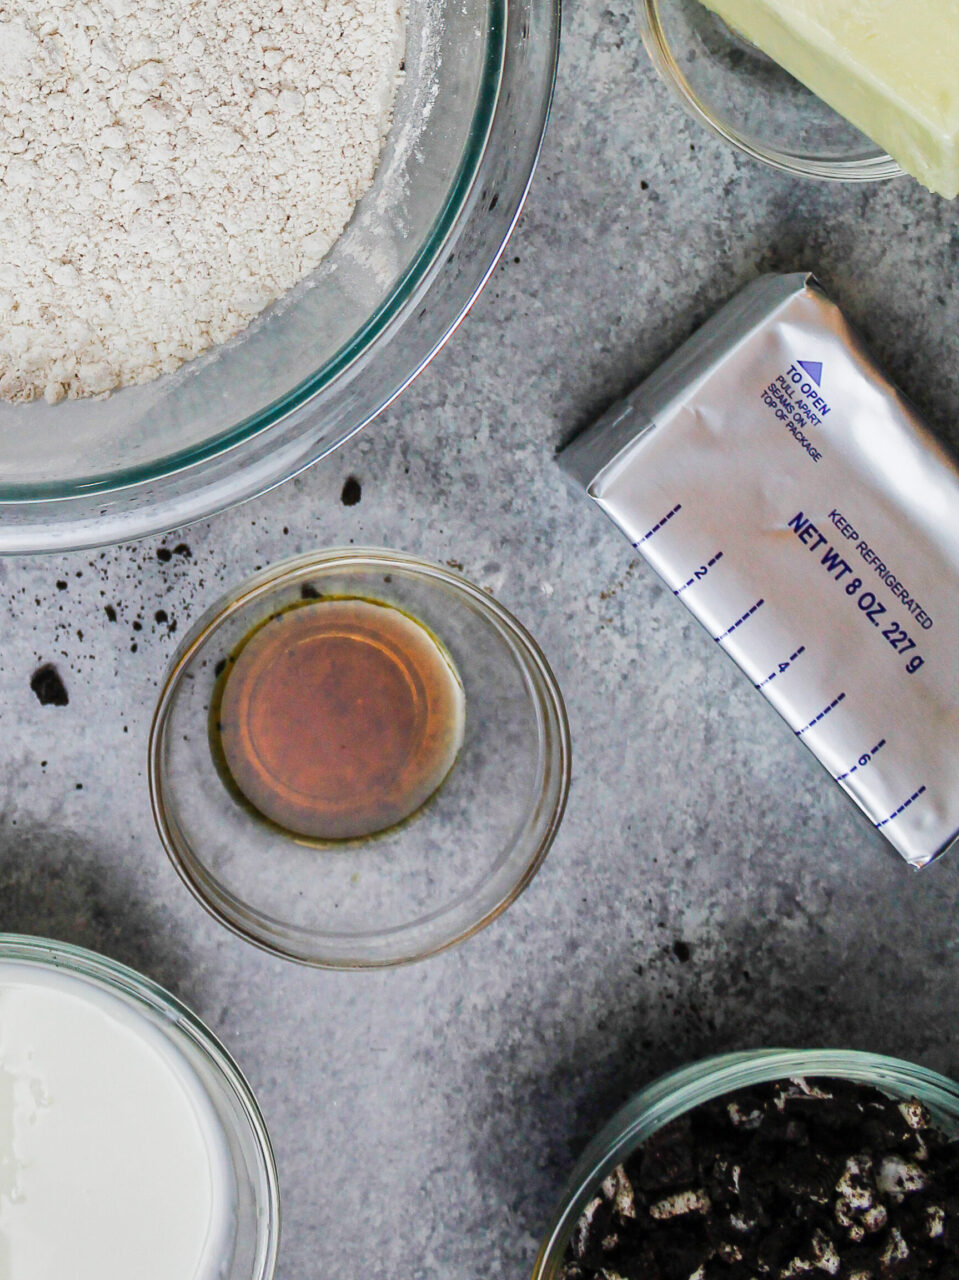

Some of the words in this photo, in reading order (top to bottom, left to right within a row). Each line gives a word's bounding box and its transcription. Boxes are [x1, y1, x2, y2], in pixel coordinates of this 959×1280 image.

[767, 383, 795, 414] SEAMS
[793, 412, 807, 428] ON
[776, 375, 796, 399] PULL
[795, 399, 822, 427] APART
[786, 364, 804, 384] TO
[800, 383, 832, 416] OPEN
[760, 389, 778, 408] TOP
[775, 408, 789, 422] OF
[786, 420, 823, 463] PACKAGE
[694, 565, 708, 580] 2
[787, 511, 828, 552] NET
[820, 546, 853, 581] WT
[845, 577, 863, 595] 8
[857, 592, 887, 628] OZ.
[881, 621, 917, 655] 227
[905, 655, 925, 674] g
[828, 509, 860, 542] KEEP
[856, 540, 933, 630] REFRIGERATED
[777, 661, 790, 673] 4
[857, 753, 872, 767] 6
